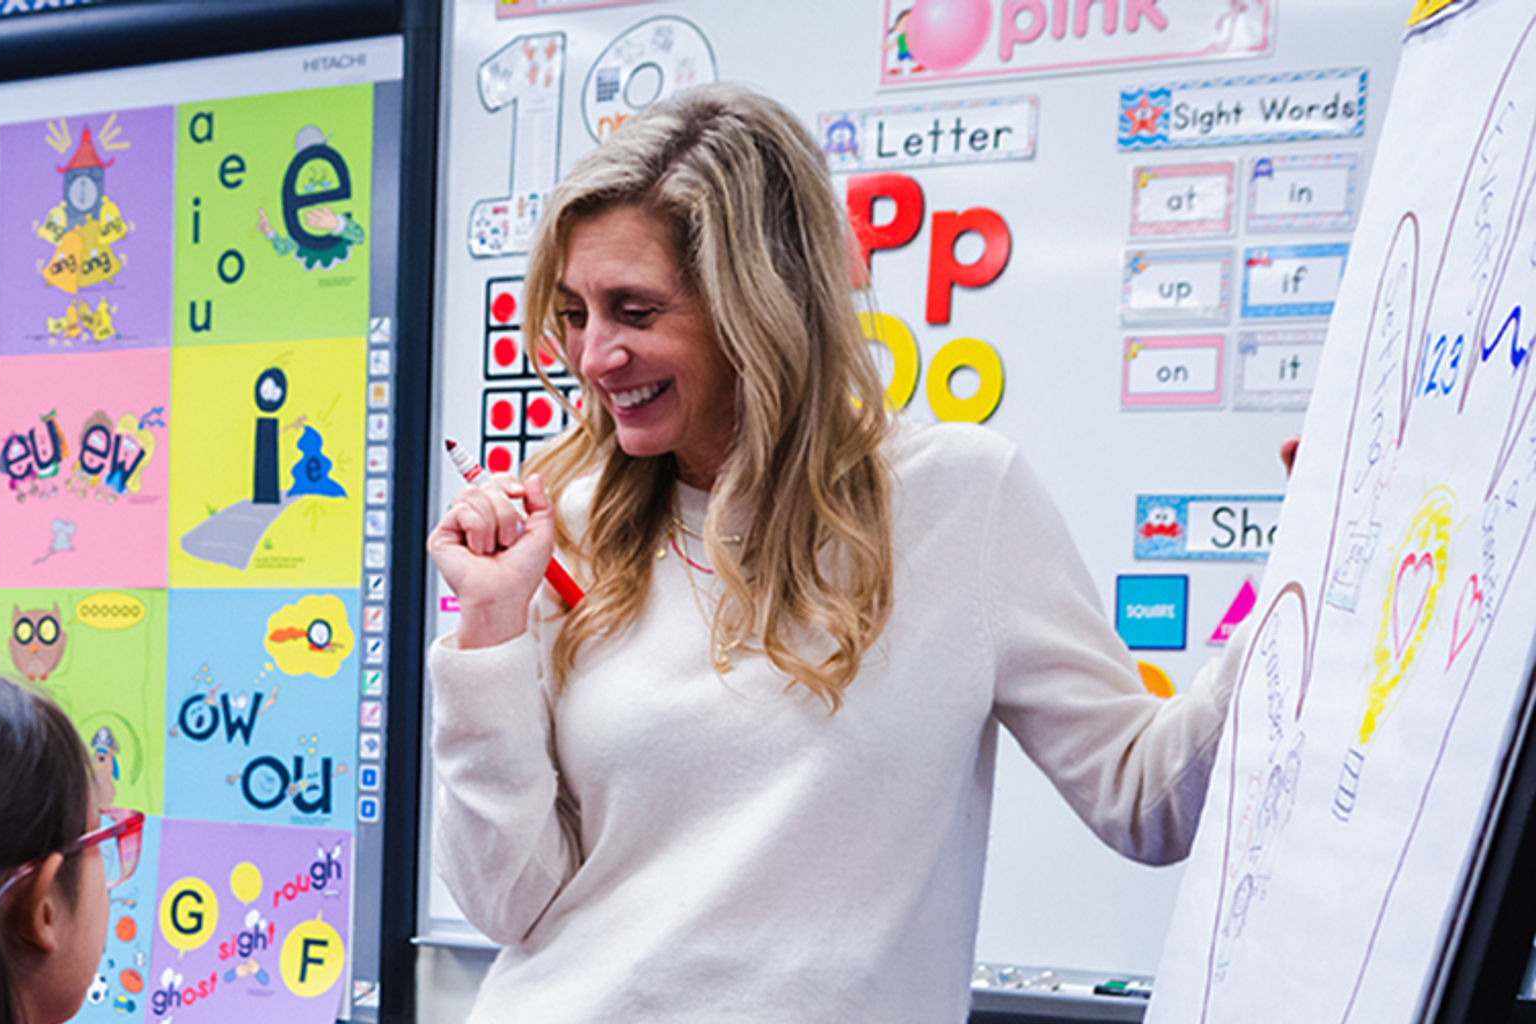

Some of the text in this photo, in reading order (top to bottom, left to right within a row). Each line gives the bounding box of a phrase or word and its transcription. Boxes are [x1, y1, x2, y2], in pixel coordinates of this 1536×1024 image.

[302, 52, 368, 73] HITACHI
[189, 111, 214, 144] a
[1173, 92, 1357, 135] Sight Words
[877, 118, 1016, 160] Letter
[218, 153, 247, 190] e
[281, 143, 352, 252] e
[1166, 186, 1198, 213] at
[1289, 182, 1314, 205] in
[192, 196, 202, 244] i
[217, 249, 245, 284] o
[846, 172, 1013, 325] Pp
[1158, 281, 1193, 307] up
[1281, 265, 1309, 294] if
[189, 300, 212, 333] u
[1156, 363, 1189, 383] on
[1278, 355, 1302, 381] it
[4, 418, 146, 493] eu ew
[305, 456, 324, 483] e
[1126, 603, 1177, 620] SQUARE
[178, 691, 265, 748] ow
[240, 755, 333, 816] ou
[272, 853, 343, 909] rough
[171, 889, 205, 936] G
[217, 921, 275, 960] sight
[298, 937, 330, 984] F
[152, 970, 218, 1017] ghost
